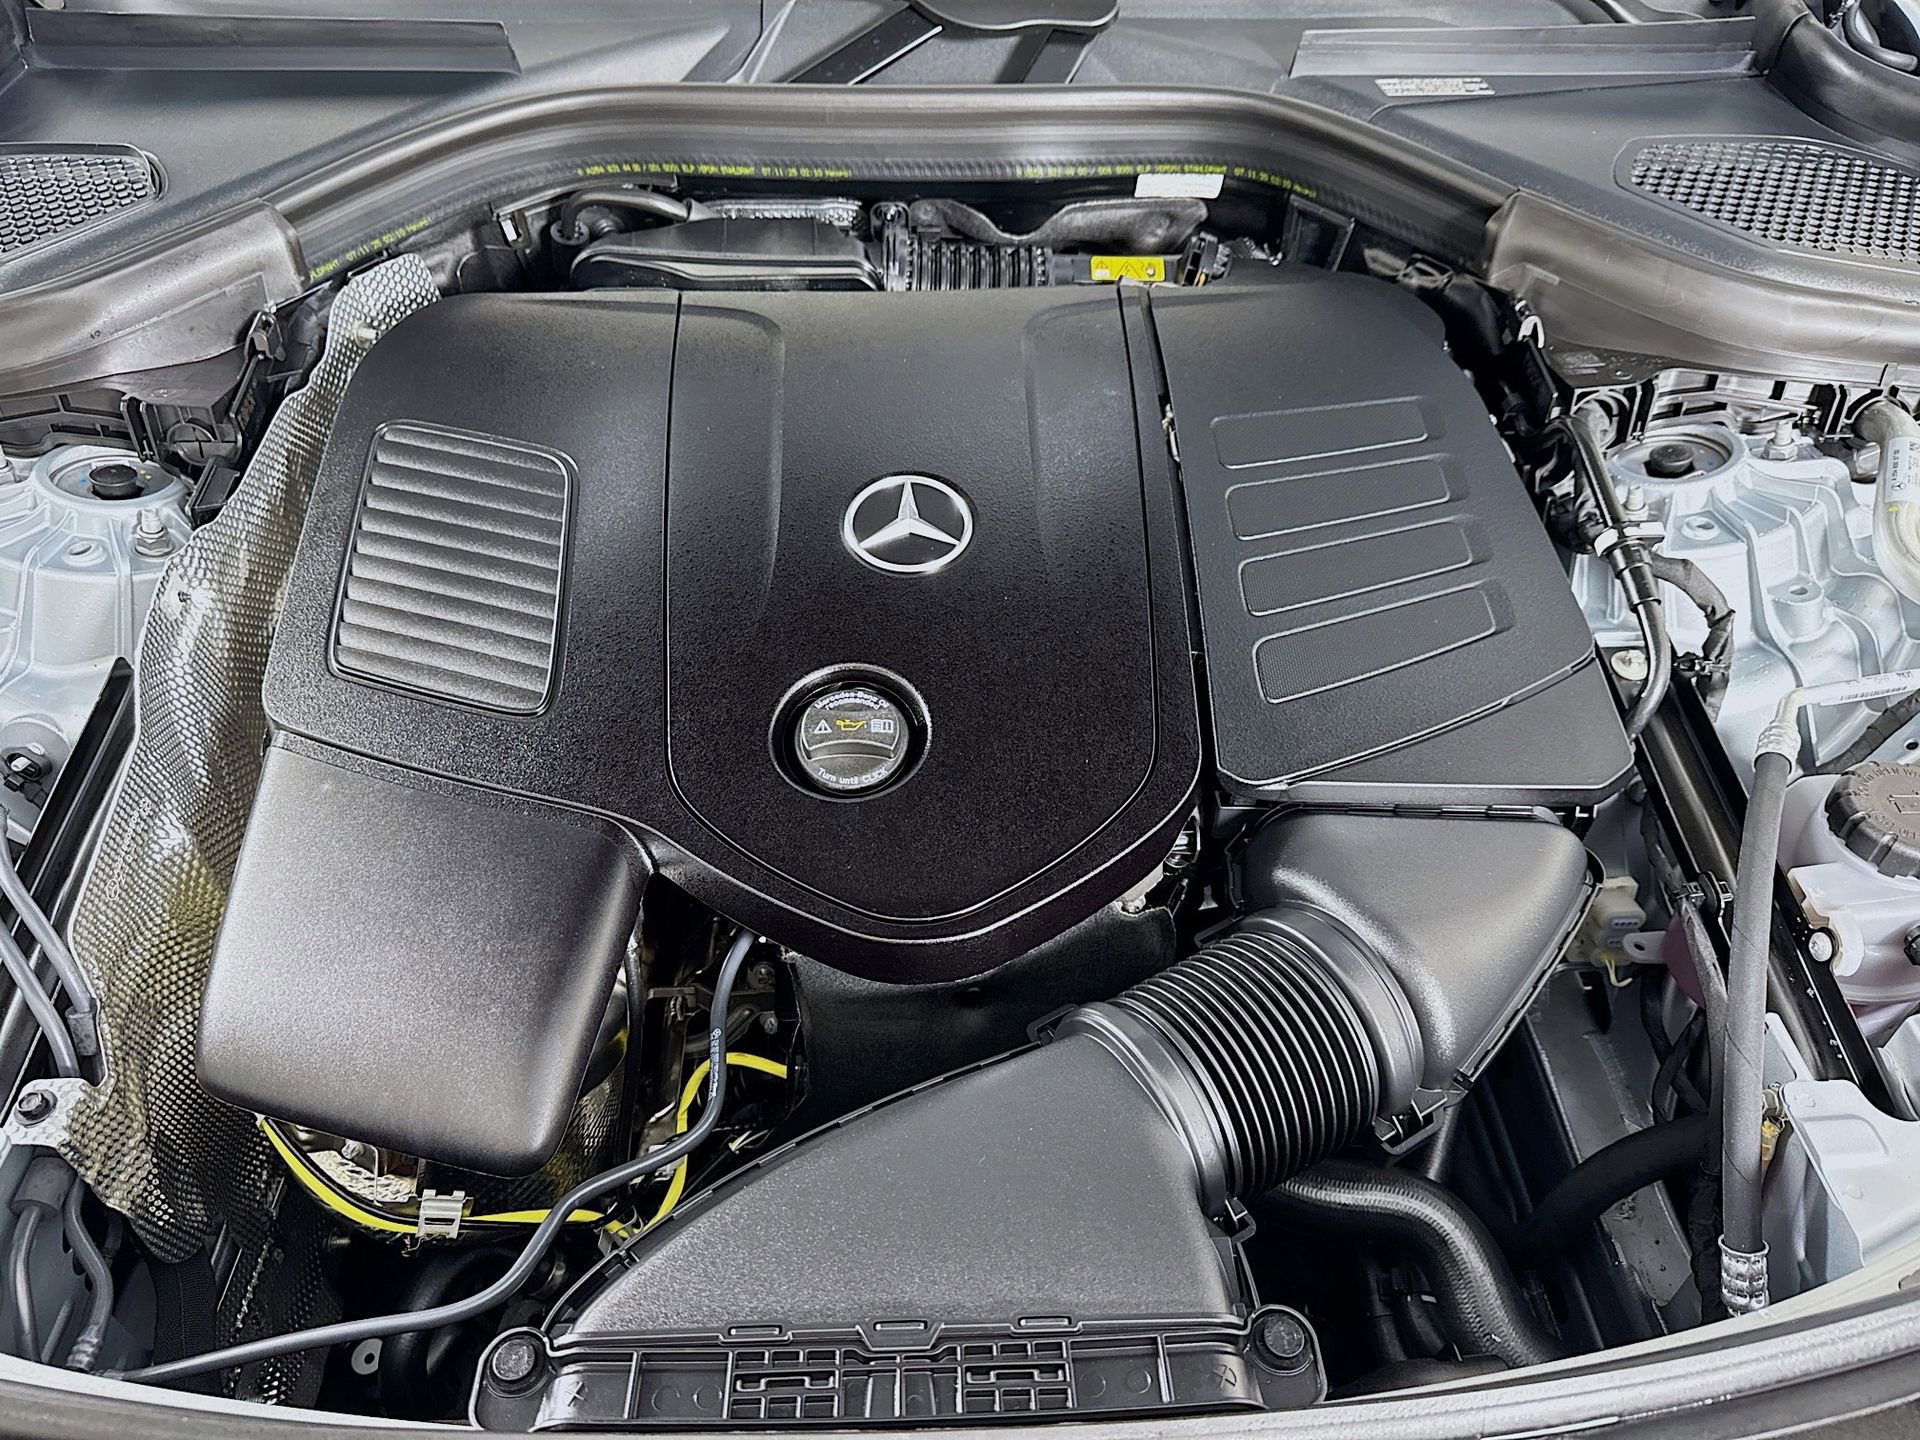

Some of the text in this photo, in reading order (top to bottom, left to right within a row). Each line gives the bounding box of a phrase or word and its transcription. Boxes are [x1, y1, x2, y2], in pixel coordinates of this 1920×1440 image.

[814, 690, 890, 709] Mercedes-Benz Oil
[825, 697, 881, 710] recommended
[817, 766, 888, 785] Turn until CLICK
